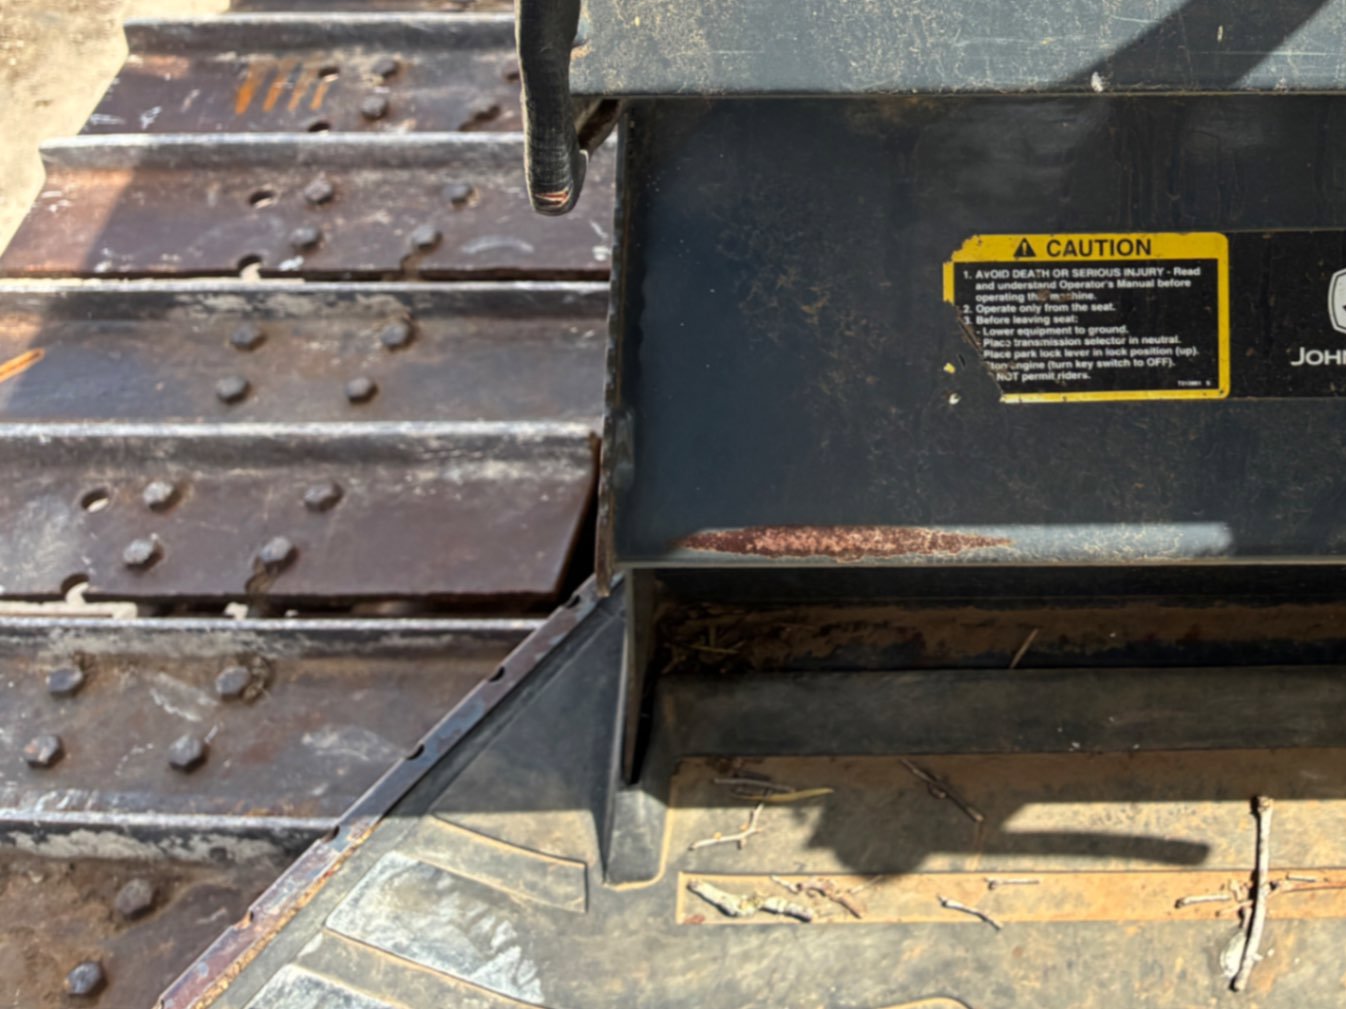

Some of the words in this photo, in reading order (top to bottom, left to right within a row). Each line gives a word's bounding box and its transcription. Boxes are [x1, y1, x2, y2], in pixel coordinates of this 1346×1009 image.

[1046, 239, 1152, 256] CAUTION
[963, 271, 972, 279] 1.
[976, 270, 1009, 278] AVOID
[1012, 270, 1050, 278] DEATH
[1053, 269, 1069, 277] OR
[1072, 268, 1121, 277] SERIOUS
[1123, 267, 1163, 276] INJURY
[1173, 267, 1200, 276] Read
[976, 281, 995, 290] and
[997, 280, 1056, 290] understand
[1059, 279, 1115, 290] Operator's
[1117, 279, 1155, 288] Manual
[1157, 279, 1191, 287] before
[976, 292, 1024, 303] operating
[1027, 292, 1048, 301] th
[1050, 291, 1097, 301] mhine.
[976, 304, 1017, 313] Operate
[1019, 303, 1041, 314] only
[1044, 303, 1069, 312] from
[1071, 302, 1089, 311] the
[1091, 303, 1116, 311] seat.
[976, 315, 1010, 324] Before
[1013, 315, 1050, 326] leaving
[1053, 314, 1078, 324] seat:
[983, 327, 1015, 336] Lower
[1017, 326, 1072, 337] equipment
[1075, 326, 1086, 334] to
[1088, 325, 1129, 336] ground.
[1014, 337, 1081, 346] transmission
[1084, 336, 1126, 345] selector
[1129, 336, 1139, 344] in
[1141, 335, 1181, 344] neutral.
[983, 349, 1011, 359] Place
[1014, 348, 1037, 359] park
[1040, 348, 1061, 357] lock
[1064, 347, 1090, 357] lever
[1093, 347, 1102, 356] in
[1105, 347, 1127, 356] lock
[1129, 346, 1173, 357] position
[1176, 346, 1200, 357] (up).
[986, 362, 1009, 372] top
[1048, 360, 1073, 370] (turn
[1075, 359, 1095, 370] key
[1097, 359, 1131, 368] switch
[1133, 359, 1144, 367] to
[1147, 358, 1176, 368] OFF).
[996, 372, 1020, 381] NOT
[1022, 372, 1055, 382] permit
[1057, 371, 1091, 380] riders.
